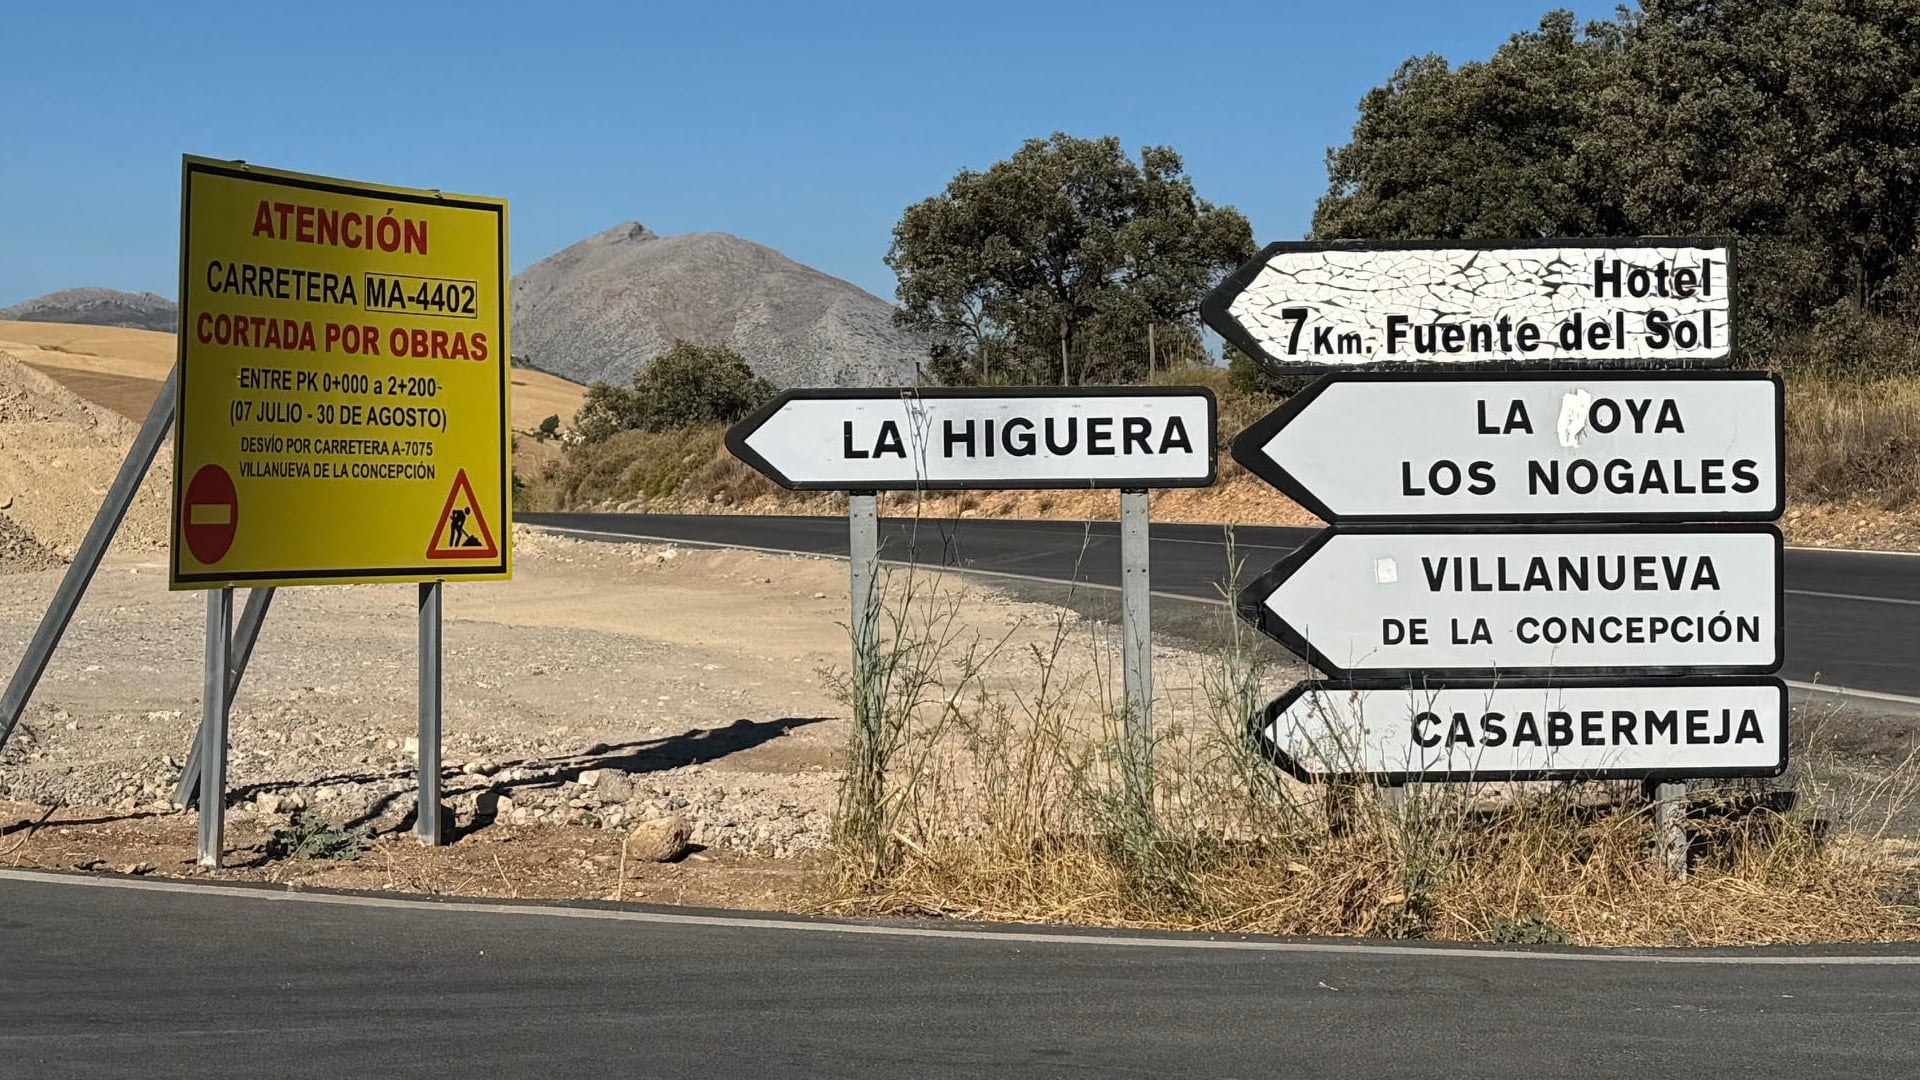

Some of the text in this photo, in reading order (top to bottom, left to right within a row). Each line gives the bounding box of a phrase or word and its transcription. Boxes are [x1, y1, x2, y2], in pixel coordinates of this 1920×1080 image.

[253, 200, 427, 255] ATENCIÓN
[207, 260, 475, 313] CARRETERA MA-4402
[1594, 257, 1711, 297] Hotel
[197, 312, 488, 361] CORTADA POR OBRAS
[1281, 308, 1712, 355] 7 Km. Fuente del Sol
[240, 367, 436, 397] ENTRE PK 0+000 a 2+200
[231, 400, 252, 426] (07
[257, 402, 302, 423] JULIO
[317, 404, 334, 424] 30
[340, 405, 362, 425] DE
[366, 406, 447, 433] AGOSTO)
[1477, 397, 1685, 435] LA OYA
[241, 433, 433, 456] DESVÍO POR CARRETERA A-7075
[843, 416, 1194, 459] LA HIGUERA
[240, 461, 435, 479] VILLANUEVA DE LA CONCEPCIÓN
[1402, 459, 1760, 496] LOS NOGALES
[1421, 555, 1720, 592] VILLANUEVA
[1382, 611, 1760, 645] DE LA CONCEPCIÓN
[1411, 709, 1765, 748] CASABERMEJA
